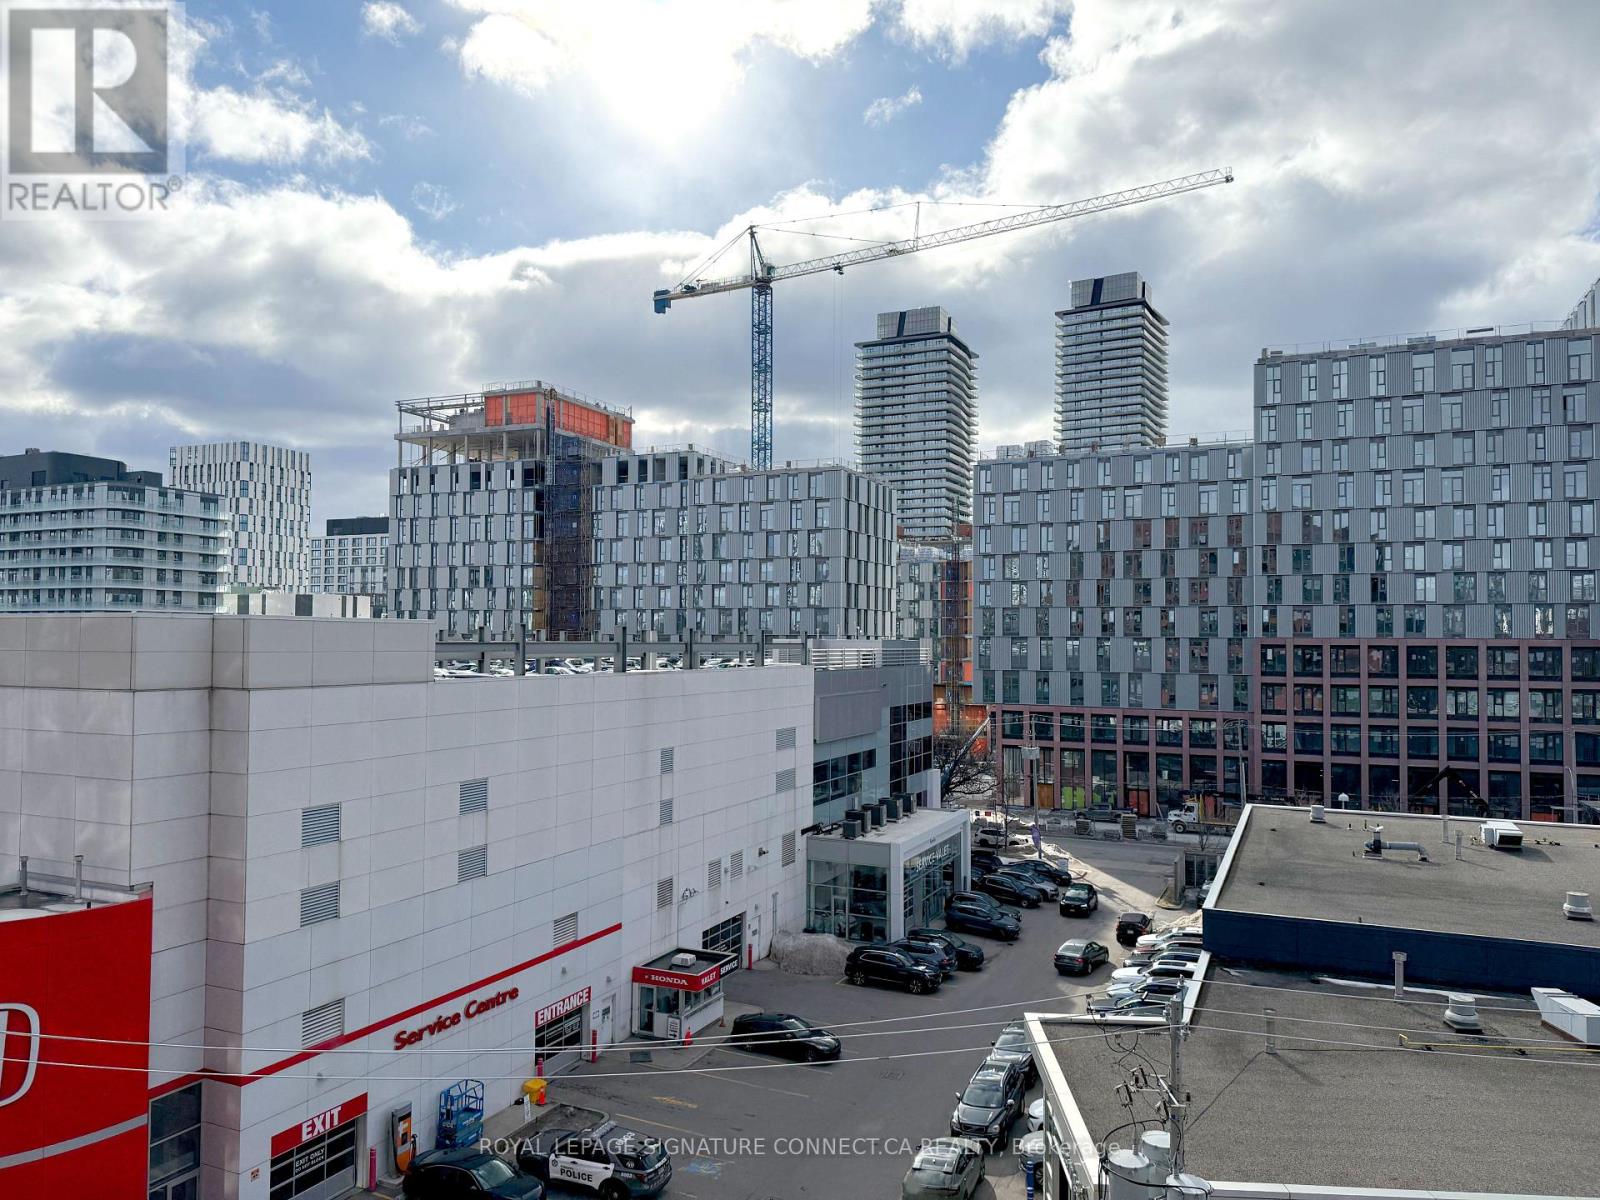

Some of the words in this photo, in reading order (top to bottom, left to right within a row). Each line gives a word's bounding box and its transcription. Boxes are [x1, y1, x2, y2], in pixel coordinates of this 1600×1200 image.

[720, 959, 738, 976] SERVICE
[651, 975, 688, 985] HONDA
[537, 988, 589, 1026] ENTRANCE
[393, 1012, 461, 1051] Service
[463, 987, 519, 1019] Centre
[302, 1106, 342, 1142] EXIT
[295, 1156, 309, 1167] EXIT
[310, 1148, 325, 1159] ONLY
[560, 1167, 593, 1183] POLICE
